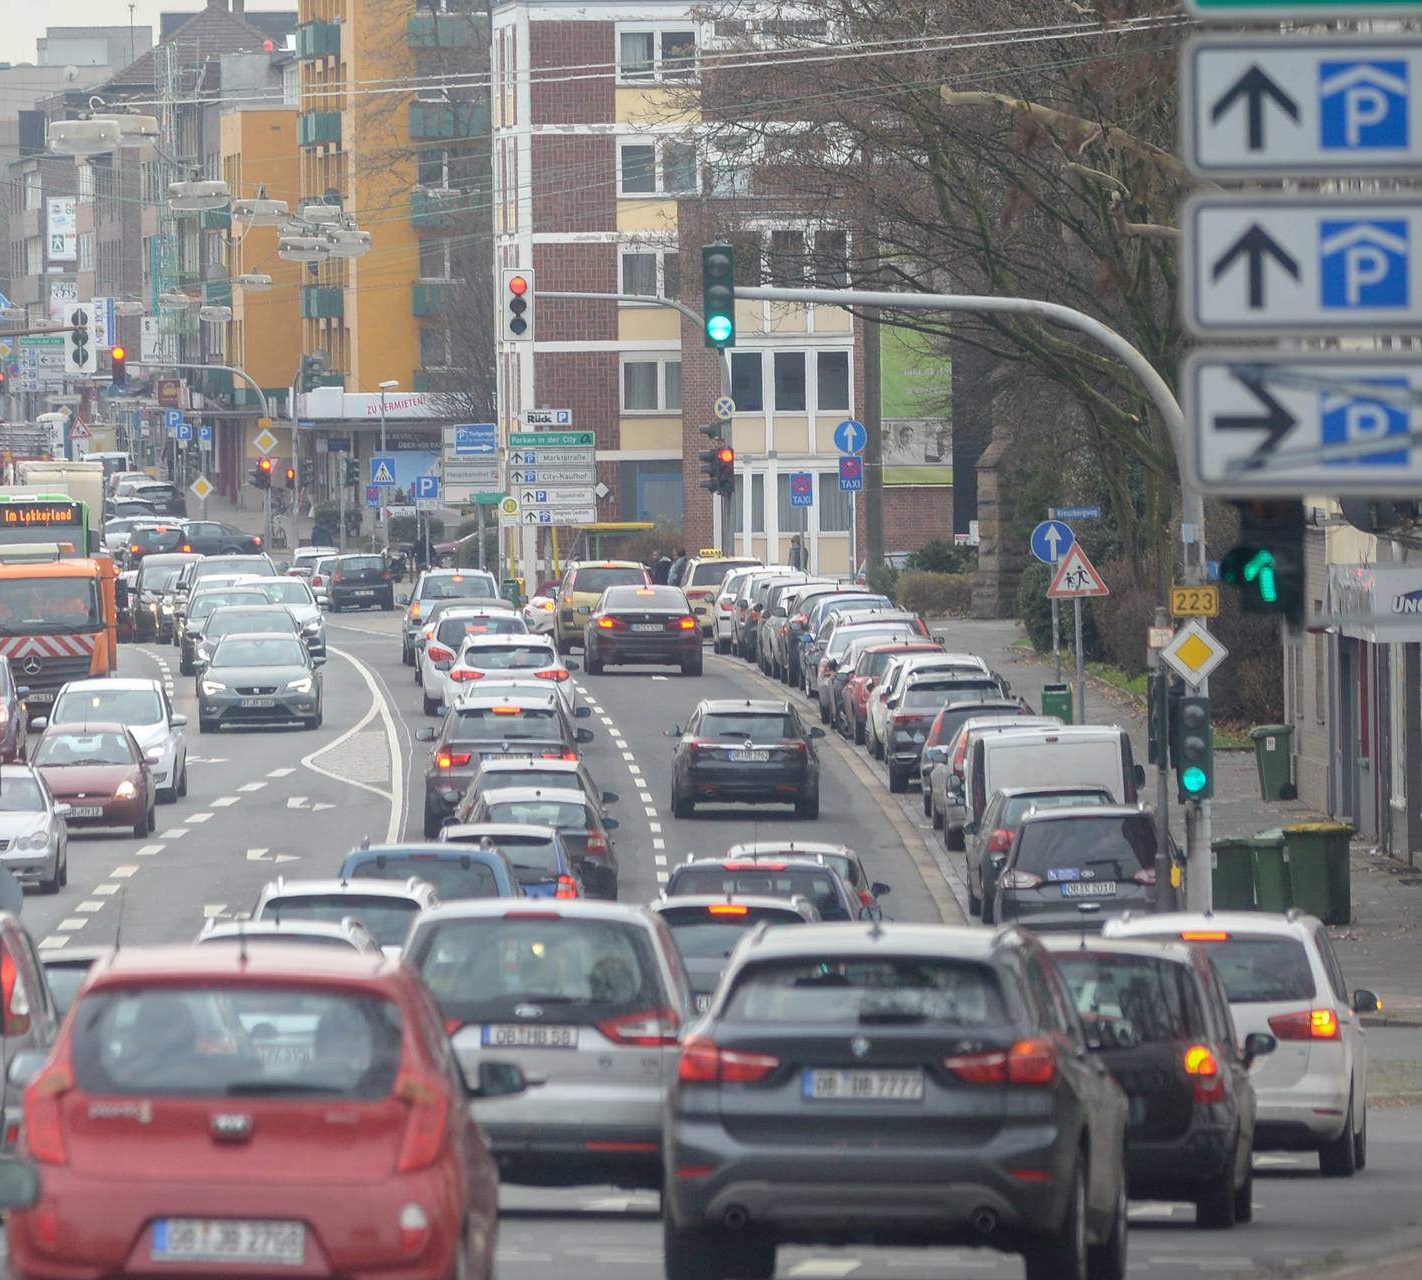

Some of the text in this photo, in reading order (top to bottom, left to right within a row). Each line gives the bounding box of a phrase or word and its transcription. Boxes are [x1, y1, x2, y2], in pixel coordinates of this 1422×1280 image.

[527, 414, 553, 423] Rück
[563, 436, 576, 444] City
[841, 480, 861, 489] TAXI
[793, 496, 811, 504] TAXI
[5, 510, 17, 521] Im
[1177, 593, 1214, 611] 223
[879, 1077, 923, 1097] 7777
